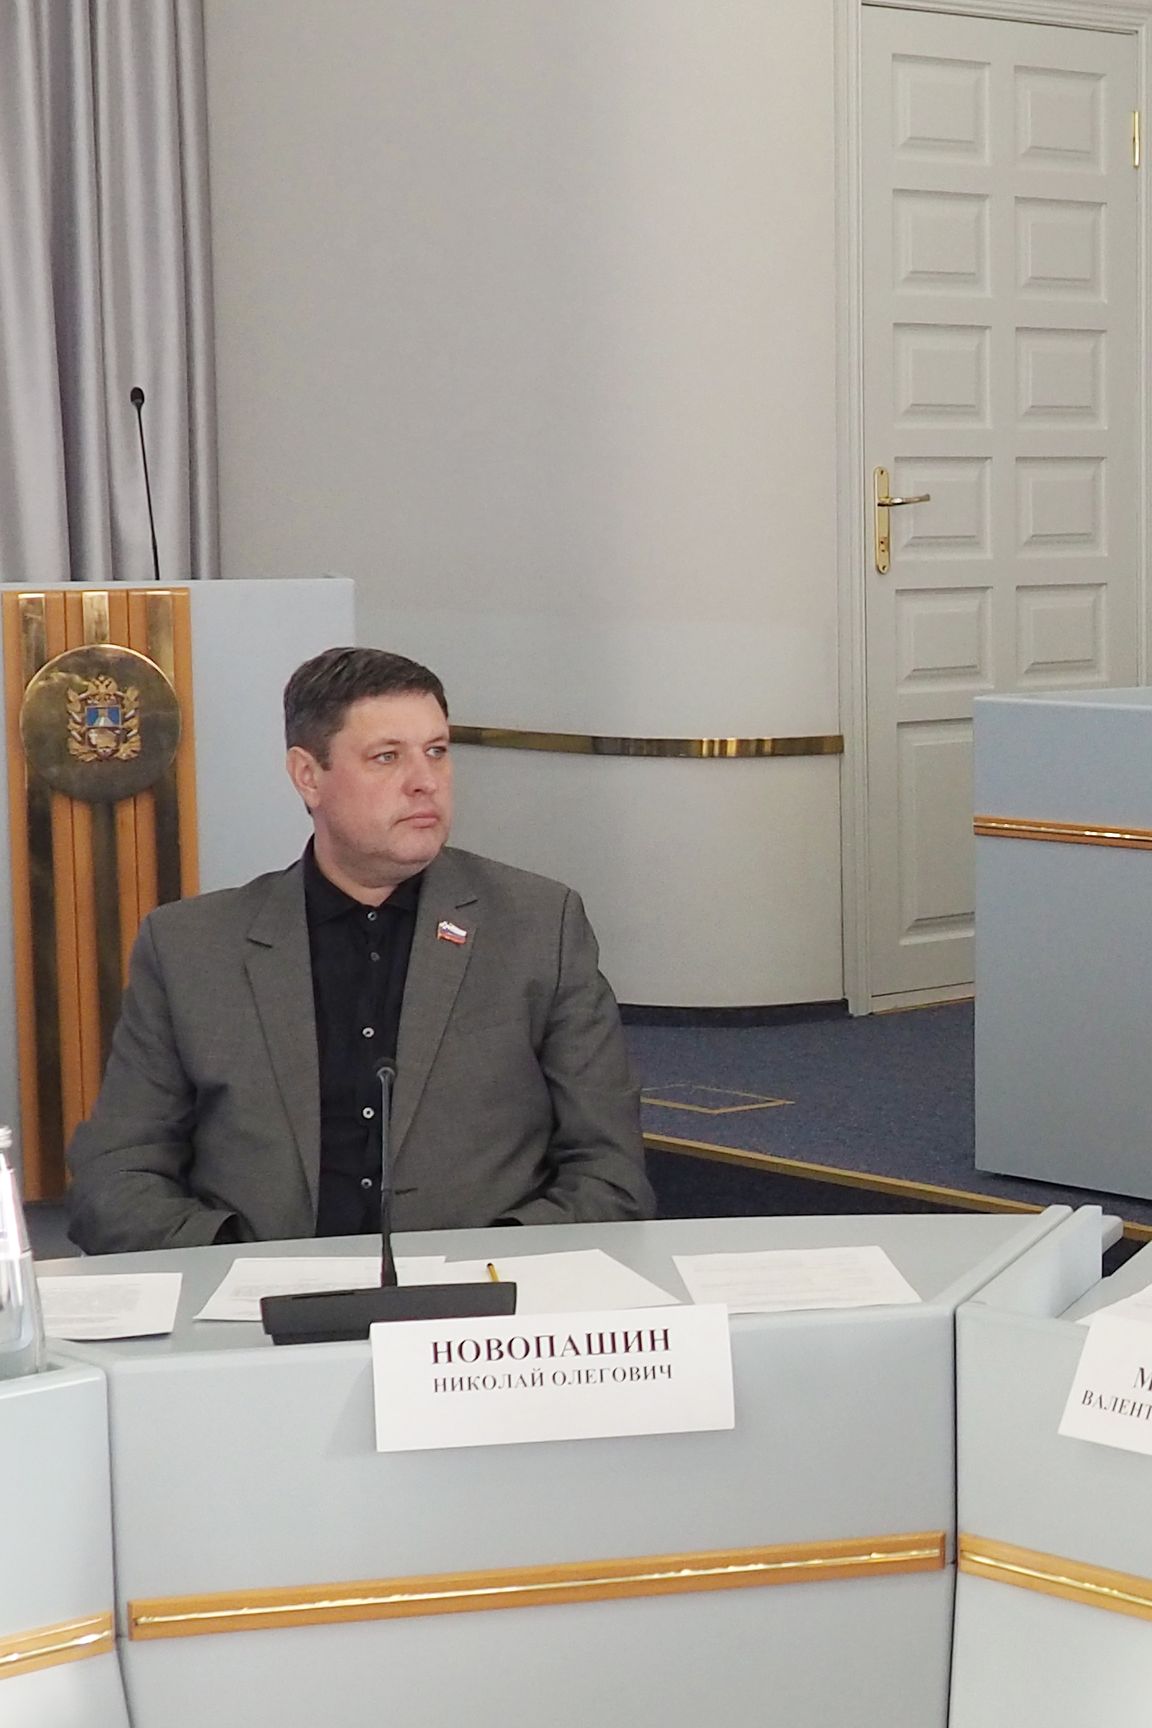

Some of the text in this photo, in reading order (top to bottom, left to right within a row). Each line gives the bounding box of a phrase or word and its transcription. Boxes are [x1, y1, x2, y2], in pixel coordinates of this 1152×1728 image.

[431, 1328, 671, 1364] НОВОПАШИН
[433, 1364, 672, 1393] НИКОЛАЙ ОЛЕГОВИЧ
